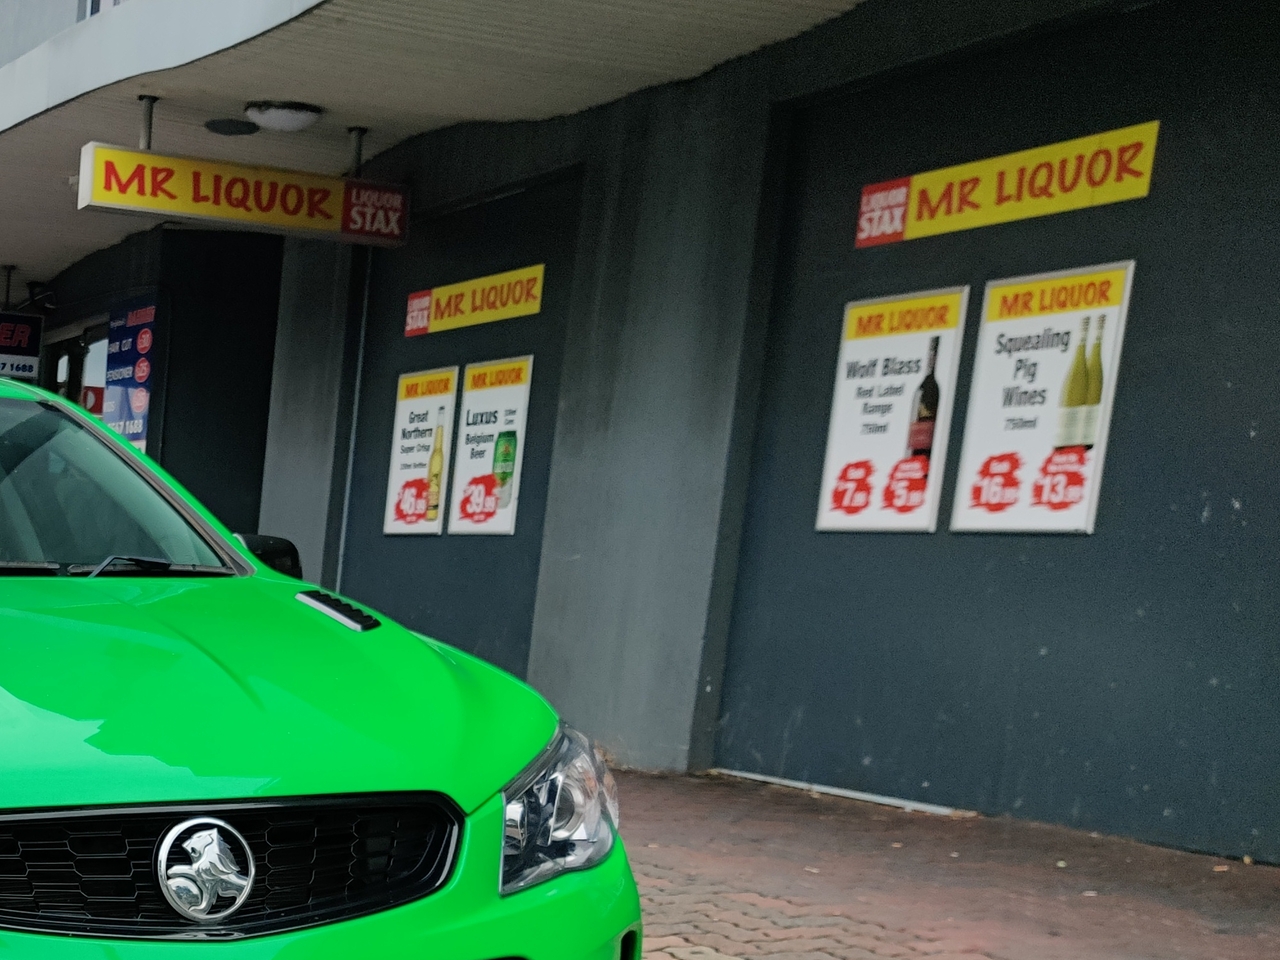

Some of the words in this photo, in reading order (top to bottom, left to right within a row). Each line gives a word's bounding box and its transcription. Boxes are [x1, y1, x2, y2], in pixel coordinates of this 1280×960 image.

[103, 160, 177, 200] MR
[192, 171, 333, 220] LIQUOR
[916, 177, 981, 222] MR
[995, 141, 1145, 206] LIQUOR
[350, 206, 401, 235] STAX
[858, 206, 905, 240] STAX
[434, 293, 465, 320] MR
[471, 277, 538, 313] LIQUOR
[999, 291, 1033, 318] MR
[1039, 280, 1111, 312] LIQUOR
[856, 313, 884, 338] MR
[888, 305, 949, 333] LIQUOR
[995, 327, 1071, 357] Squealing
[10, 362, 34, 373] 1688
[489, 367, 523, 386] LIQUOR
[882, 357, 921, 376] Blass
[1013, 358, 1038, 384] Pig
[1002, 386, 1047, 408] Wines
[408, 410, 429, 424] Great
[466, 409, 498, 427] Luxus
[400, 427, 433, 441] Northern
[465, 433, 494, 447] Belgium
[470, 447, 486, 460] Beer
